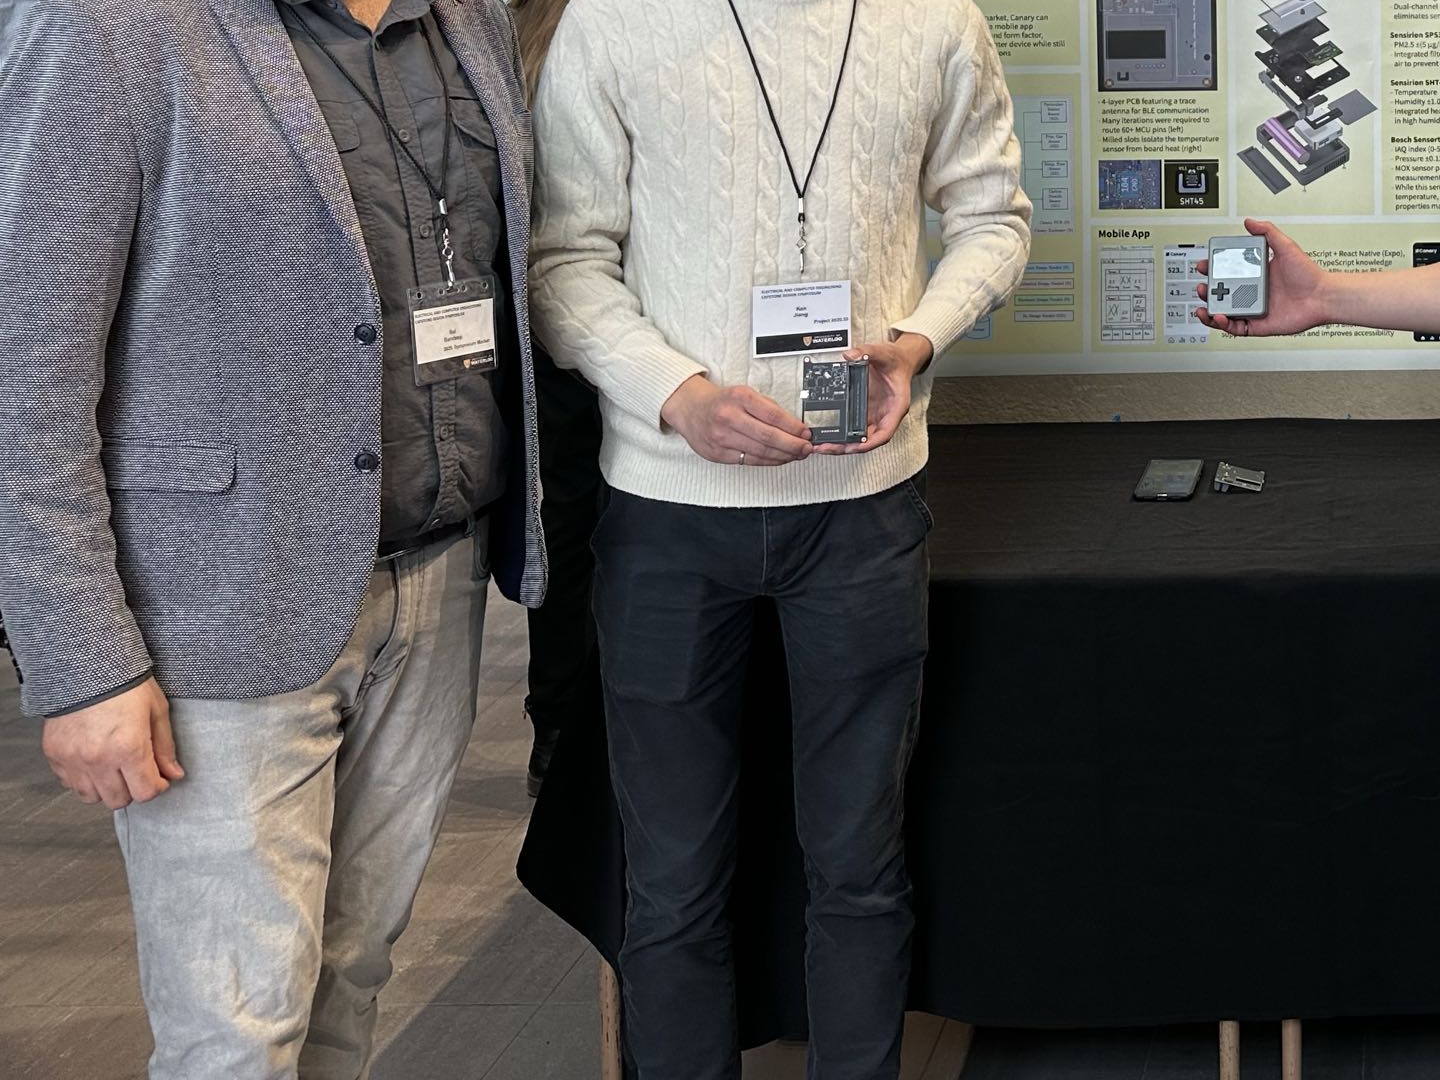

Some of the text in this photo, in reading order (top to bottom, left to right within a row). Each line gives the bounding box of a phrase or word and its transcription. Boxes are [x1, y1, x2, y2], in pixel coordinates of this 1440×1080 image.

[1394, 51, 1428, 59] Integrated
[1395, 89, 1437, 97] Temperature
[1102, 98, 1124, 106] 4-layer
[1142, 98, 1172, 106] featuring
[1395, 98, 1425, 107] Humidity
[1395, 108, 1429, 116] Integrated
[1173, 116, 1201, 125] required
[1168, 126, 1183, 134] (left)
[1178, 136, 1219, 144] temperature
[1182, 145, 1201, 153] (right)
[1132, 230, 1150, 239] App
